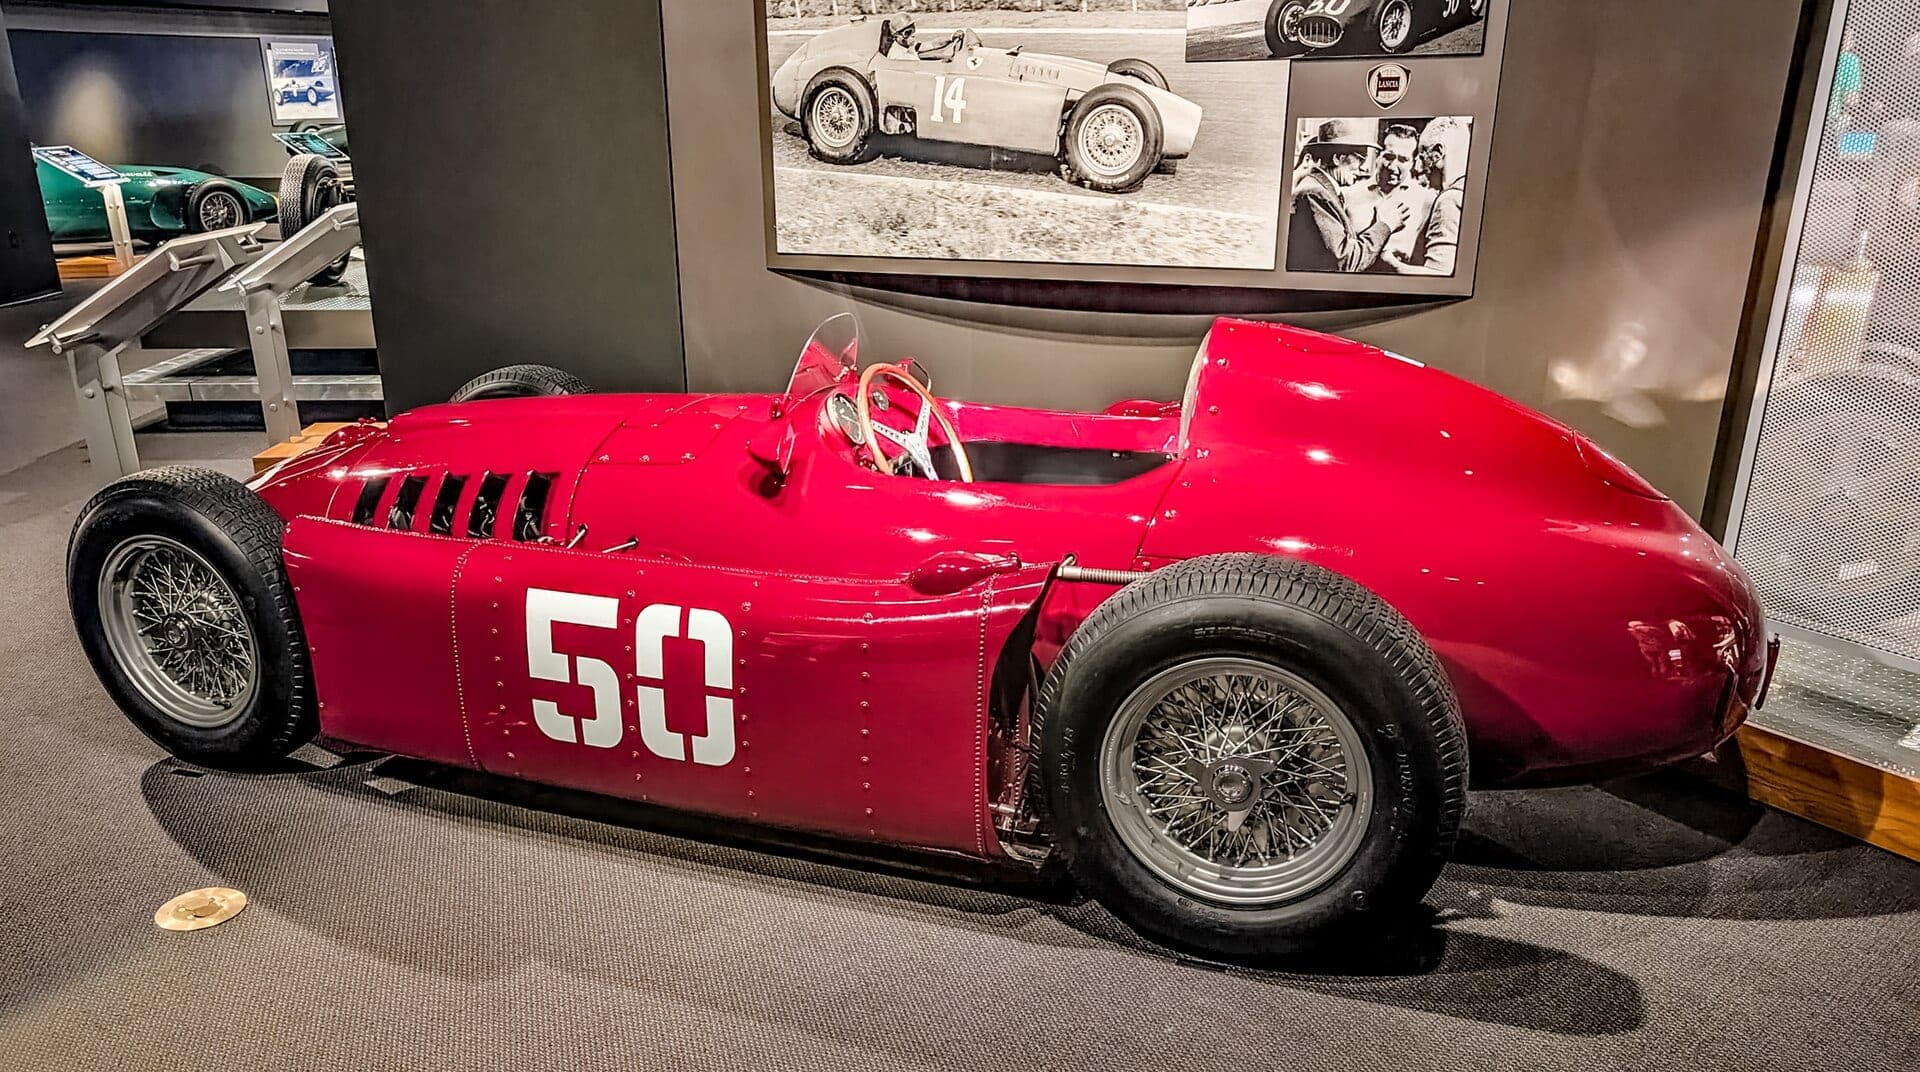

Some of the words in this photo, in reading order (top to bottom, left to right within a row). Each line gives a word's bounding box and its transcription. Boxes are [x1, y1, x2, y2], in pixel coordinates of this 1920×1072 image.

[930, 75, 967, 124] 14
[1378, 80, 1399, 88] LANCIA
[525, 587, 736, 767] 50
